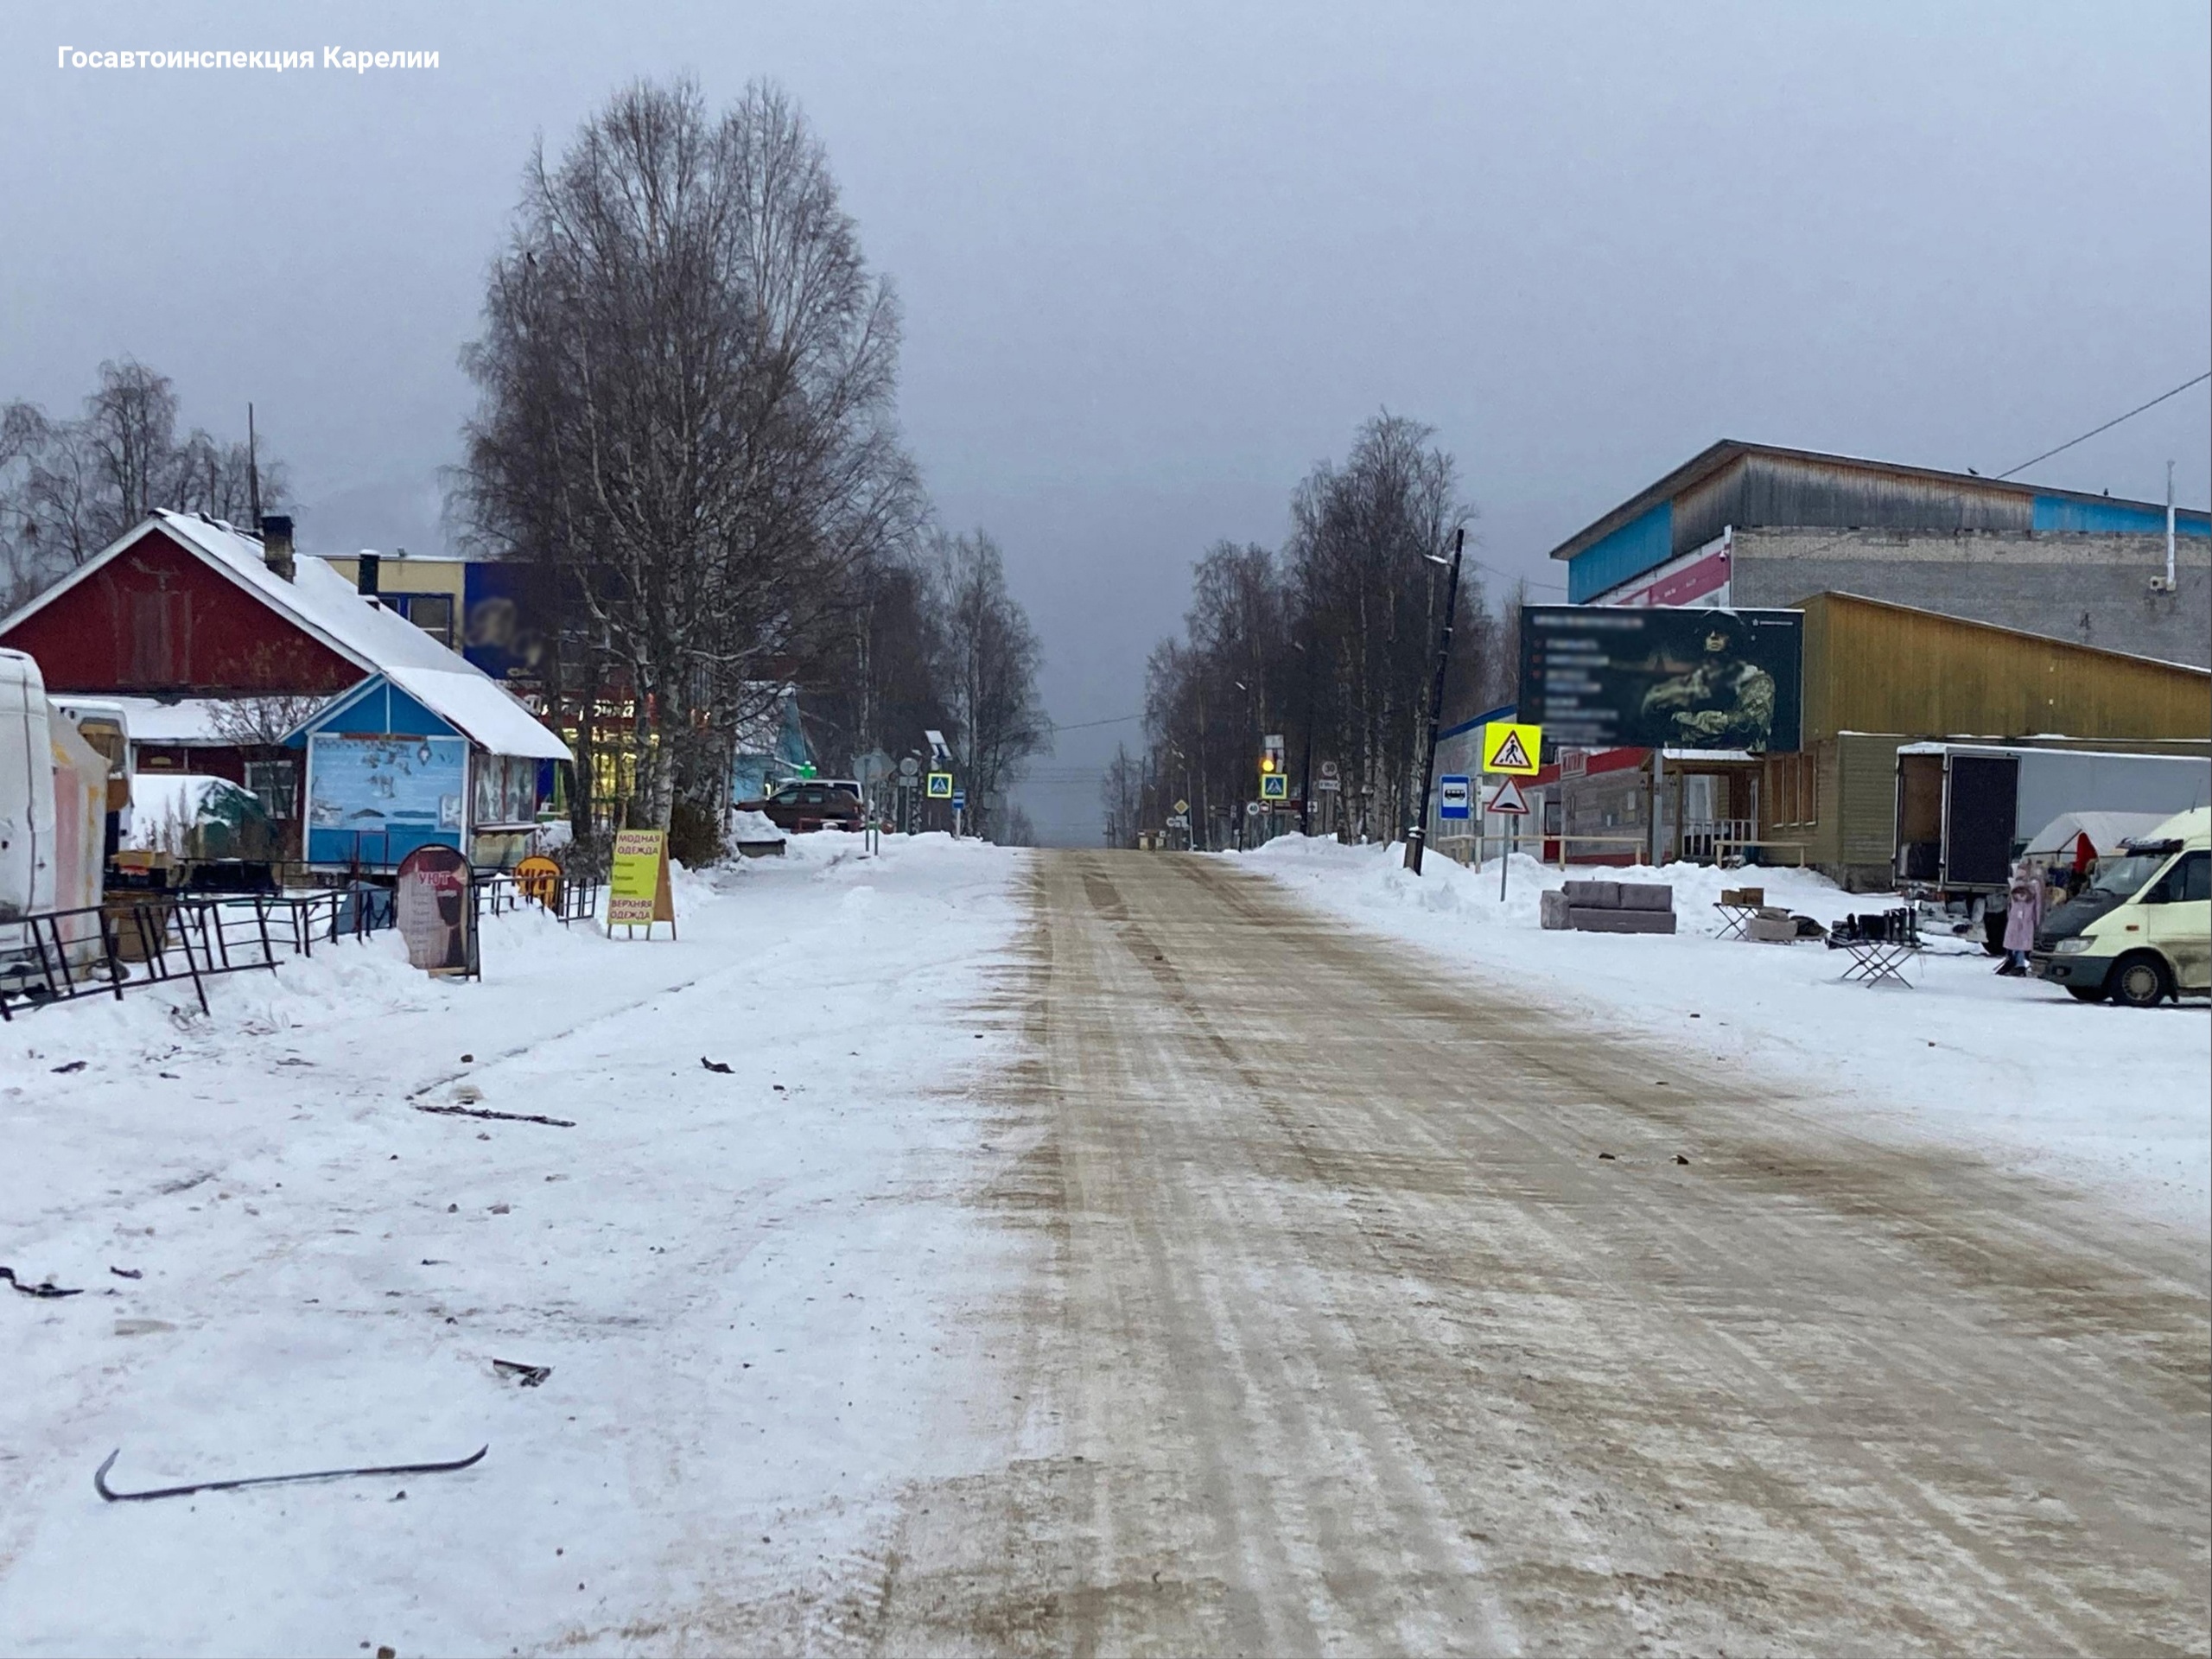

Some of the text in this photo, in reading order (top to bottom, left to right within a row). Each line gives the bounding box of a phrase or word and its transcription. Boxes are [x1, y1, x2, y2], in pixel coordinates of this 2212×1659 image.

[618, 834, 660, 843] МОДНАЯ
[617, 846, 658, 855] ОДЕЖДА
[419, 871, 451, 886] УЮТ
[611, 899, 652, 908] ВЕРХНЯЯ
[610, 911, 651, 919] ОДЕЖДА
